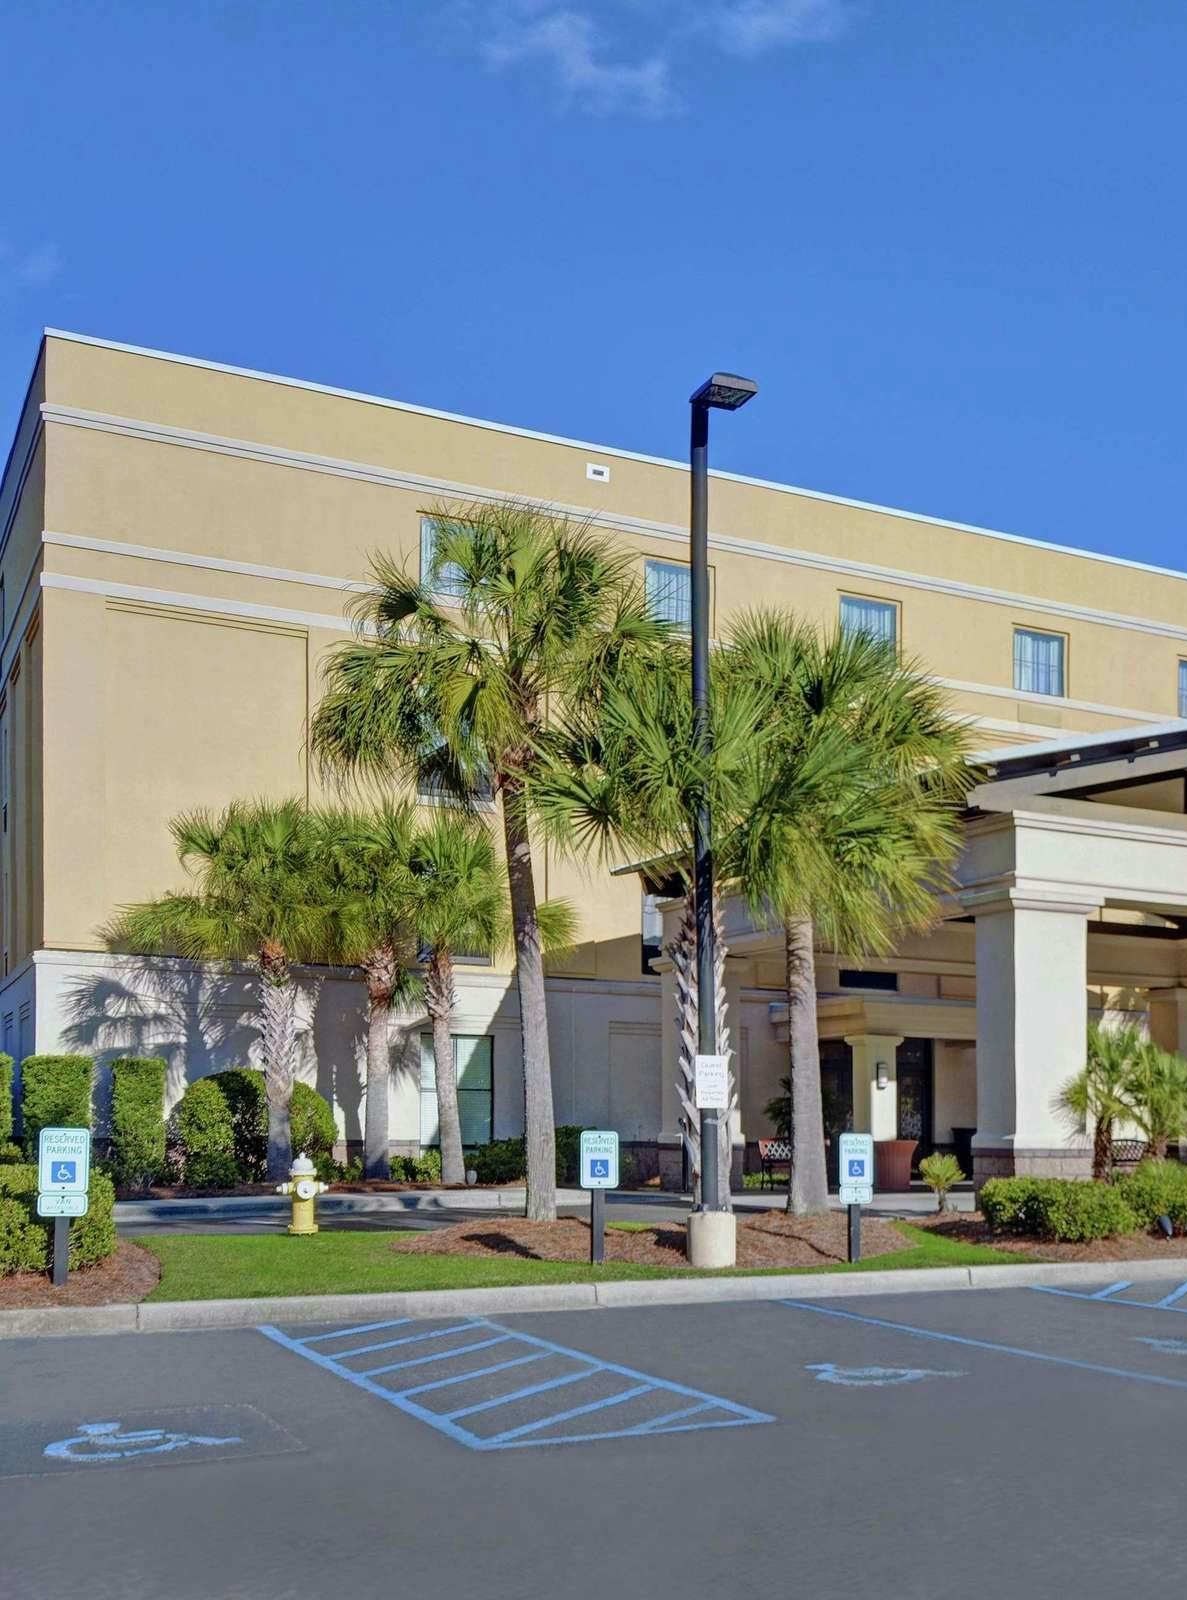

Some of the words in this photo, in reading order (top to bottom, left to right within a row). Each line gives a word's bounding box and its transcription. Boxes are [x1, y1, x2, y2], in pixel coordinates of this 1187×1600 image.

[44, 1135, 85, 1144] RESERVED
[583, 1136, 615, 1145] RESERVED
[46, 1146, 82, 1154] PARKING
[585, 1145, 614, 1153] PARKING
